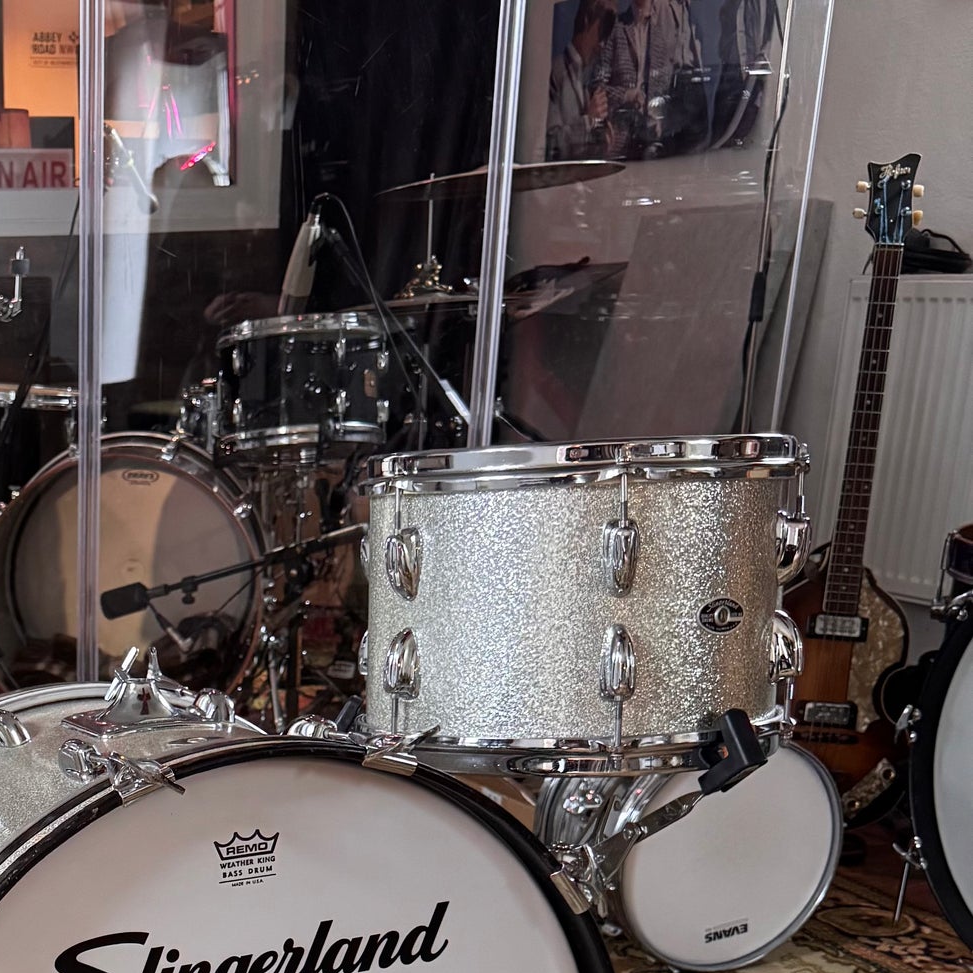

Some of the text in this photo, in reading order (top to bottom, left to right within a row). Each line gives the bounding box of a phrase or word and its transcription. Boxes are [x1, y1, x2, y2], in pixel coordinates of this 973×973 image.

[33, 31, 62, 42] ABBEY
[32, 43, 56, 54] ROAD
[22, 160, 68, 188] AIR
[226, 842, 268, 856] REMO
[220, 855, 276, 869] WEATHER KING
[222, 865, 273, 878] BASS DRUM
[704, 923, 748, 943] EVANS
